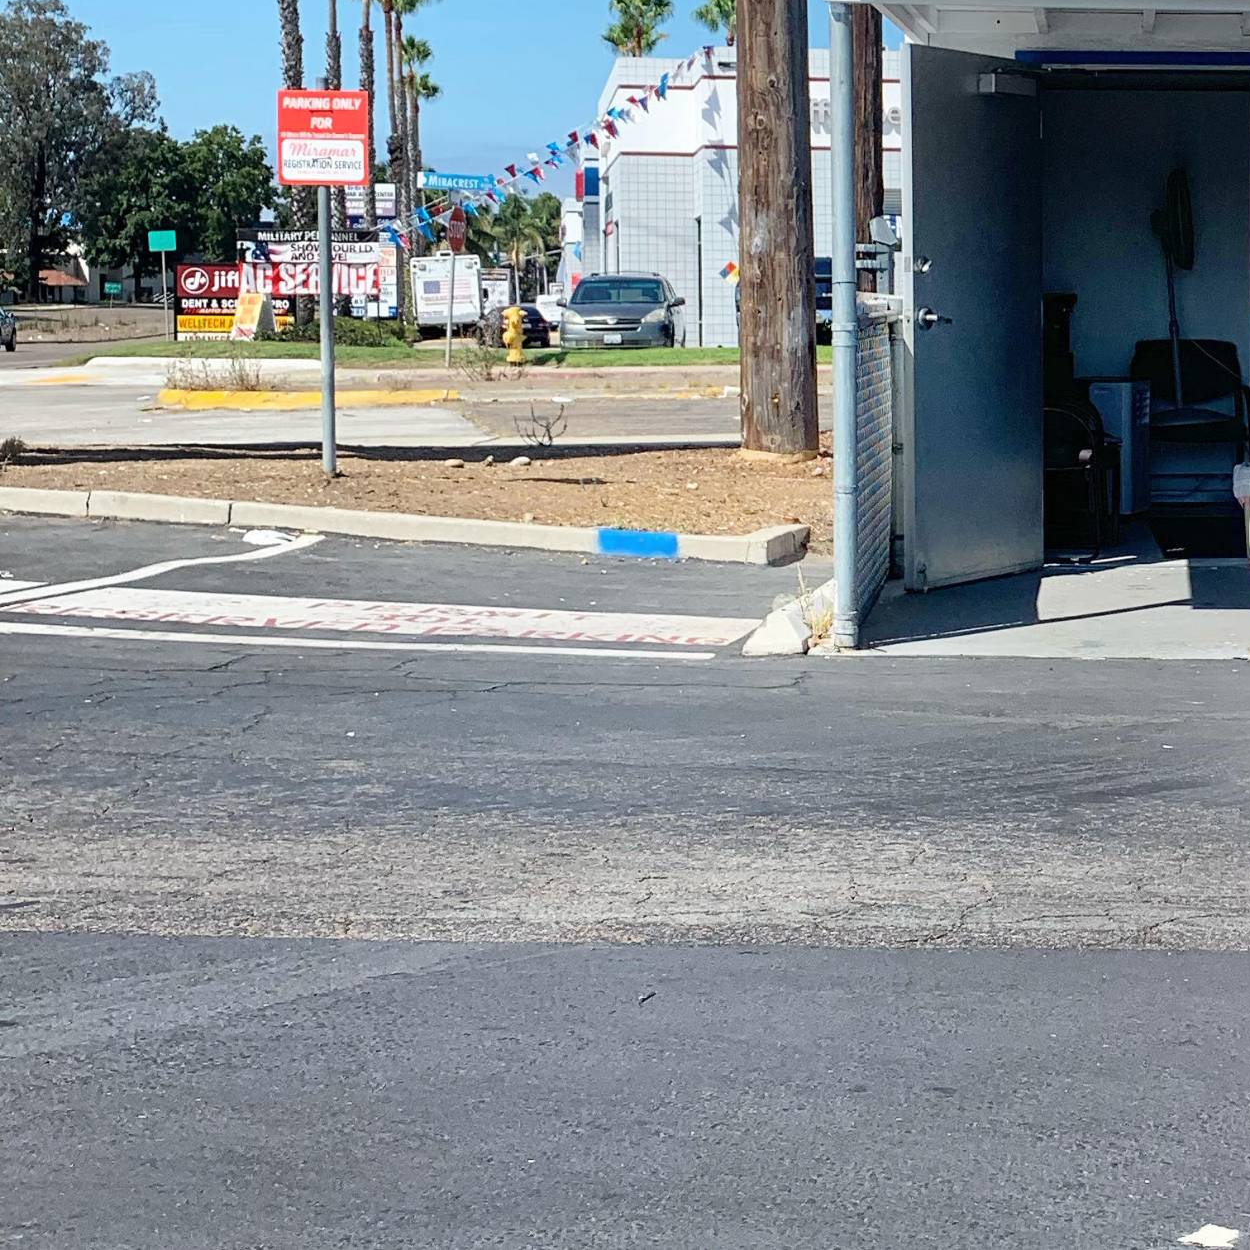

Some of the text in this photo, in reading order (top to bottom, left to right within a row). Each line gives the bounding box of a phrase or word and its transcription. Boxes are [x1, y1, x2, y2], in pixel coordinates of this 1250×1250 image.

[282, 97, 361, 110] PARKING ONLY
[310, 117, 332, 129] FOR
[289, 143, 356, 158] Miramar
[284, 159, 362, 170] REGISTRATION SERVICE
[428, 175, 478, 189] MIRACREST
[449, 220, 464, 238] STOP
[258, 232, 359, 242] MILITARY PENNEL
[332, 244, 358, 253] OUR
[290, 252, 315, 261] AND
[240, 263, 273, 294] AC
[182, 299, 209, 308] DENT
[211, 299, 219, 308] &
[179, 318, 226, 329] WELLTECH
[306, 601, 610, 621] PERMIT
[2, 603, 732, 646] RESERVED PARKING
